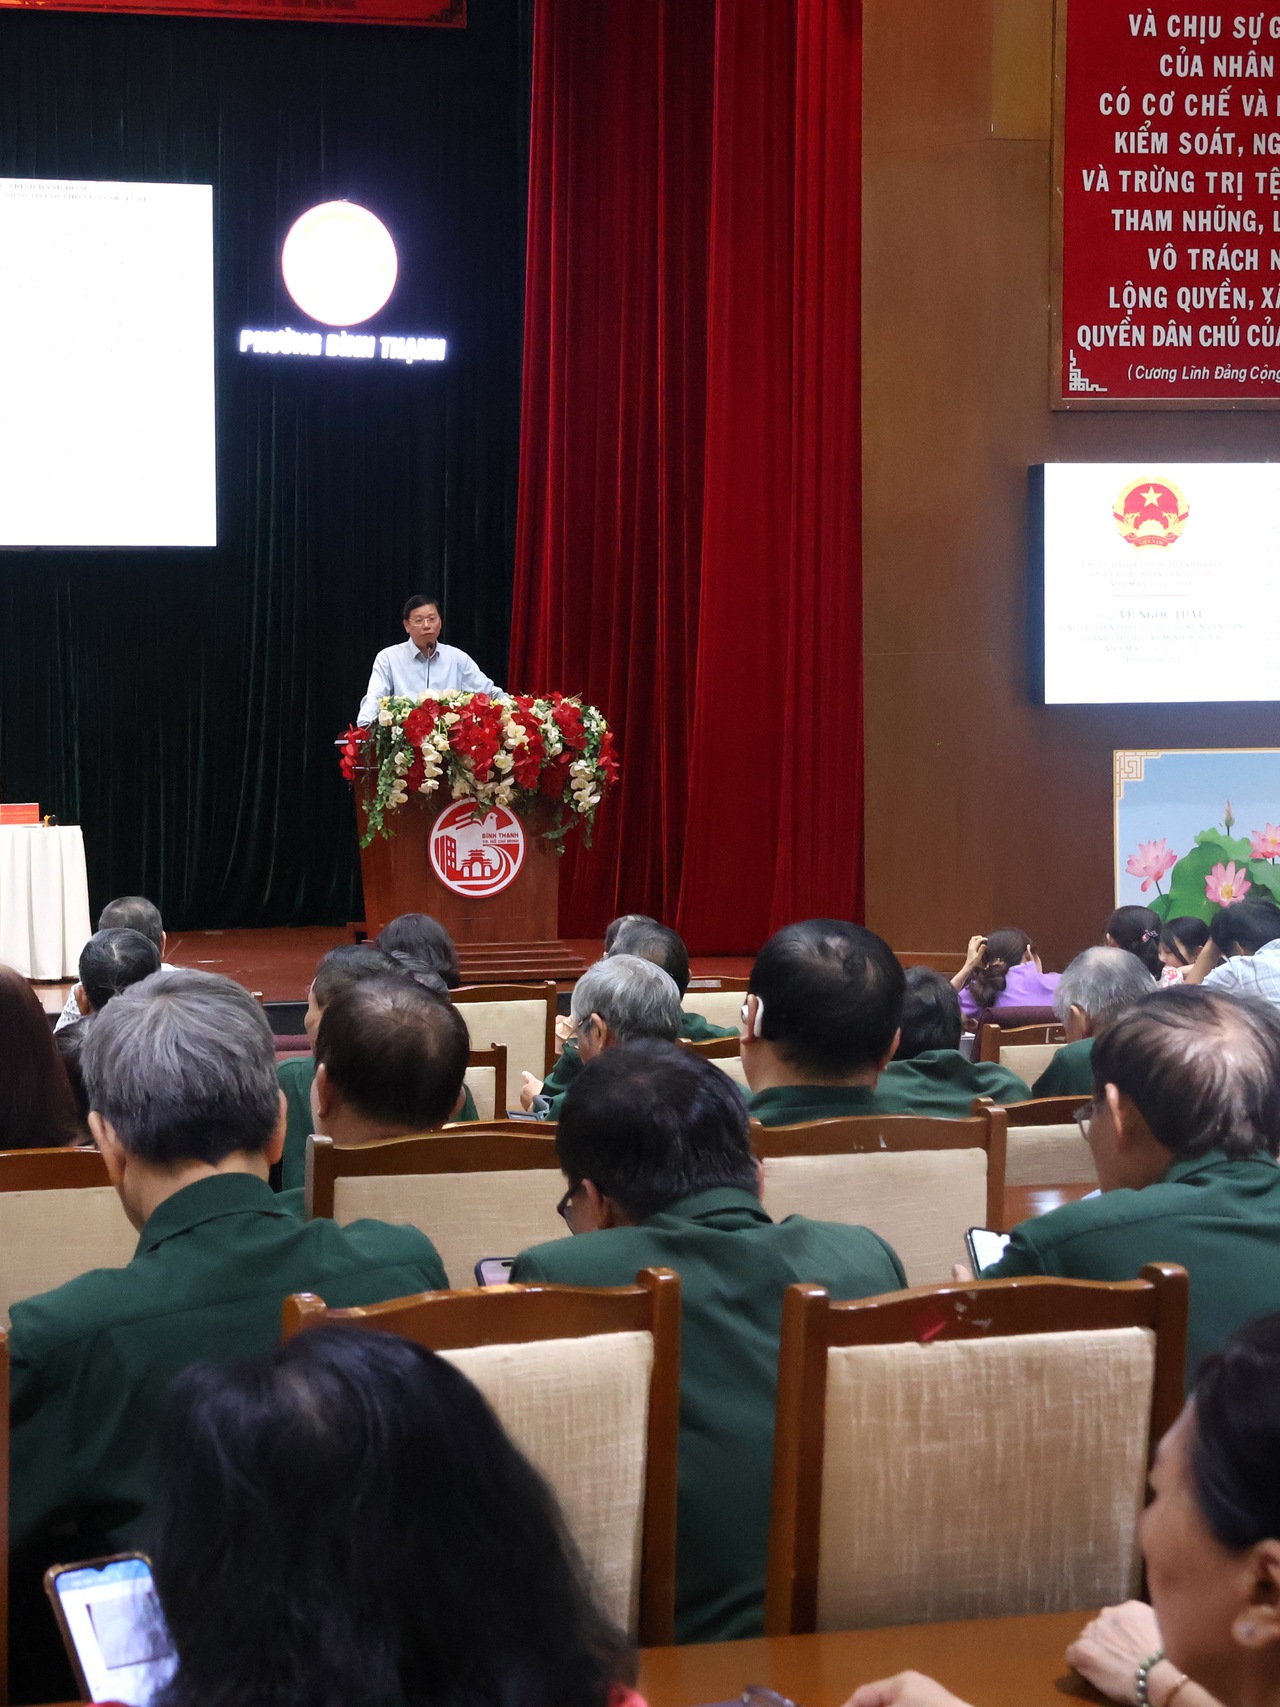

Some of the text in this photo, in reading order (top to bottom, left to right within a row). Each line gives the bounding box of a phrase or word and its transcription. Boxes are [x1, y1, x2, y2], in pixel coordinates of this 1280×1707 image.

[1128, 8, 1157, 37] VÀ
[1167, 15, 1222, 44] CHỊU
[1232, 12, 1264, 45] SỰ
[1159, 46, 1274, 78] CỦA NHÂN
[1099, 85, 1131, 116] CÓ
[1142, 91, 1175, 116] CƠ
[1184, 85, 1232, 117] CHẾ
[1241, 88, 1269, 117] VÀ
[1115, 120, 1168, 154] KIỂM
[1178, 126, 1244, 157] SOÁT,
[1082, 164, 1110, 192] VÀ
[1119, 164, 1195, 193] TRỪNG
[1205, 172, 1243, 201] TRỊ
[1111, 209, 1173, 231] THAM
[1182, 204, 1264, 235] NHŨNG,
[1147, 242, 1177, 270] VÔ
[1187, 243, 1259, 271] TRÁCH
[1109, 280, 1168, 315] LỘNG
[1176, 278, 1255, 313] QUYỀN,
[1077, 316, 1145, 351] QUYỀN
[1152, 320, 1192, 347] DÂN
[1199, 316, 1240, 347] CHỦ
[1182, 365, 1210, 380] Lĩnh
[1214, 364, 1247, 382] Đảng
